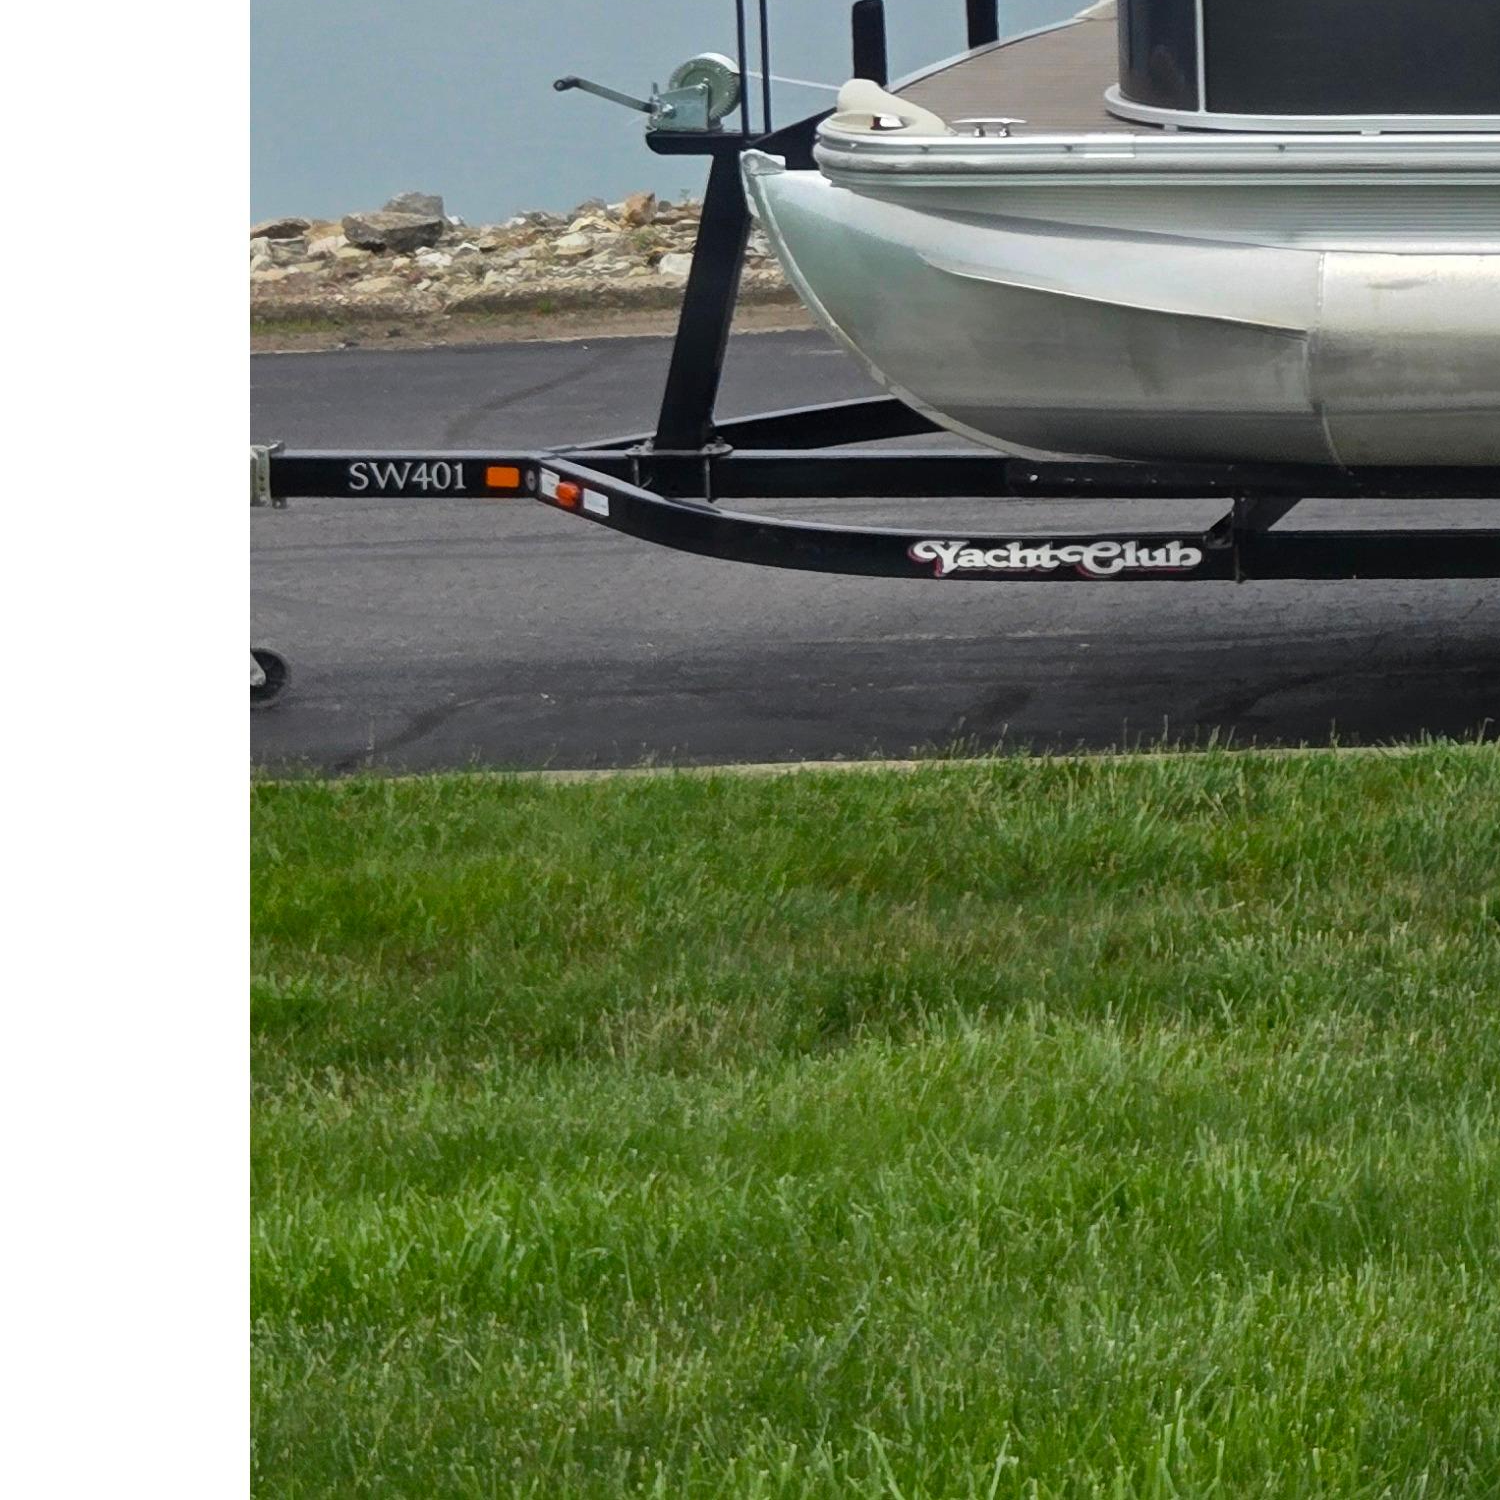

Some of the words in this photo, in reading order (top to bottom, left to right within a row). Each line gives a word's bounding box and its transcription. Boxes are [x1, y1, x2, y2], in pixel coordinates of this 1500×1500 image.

[349, 461, 467, 491] SW401
[911, 540, 1059, 575] Yacht
[1058, 540, 1202, 575] Club
